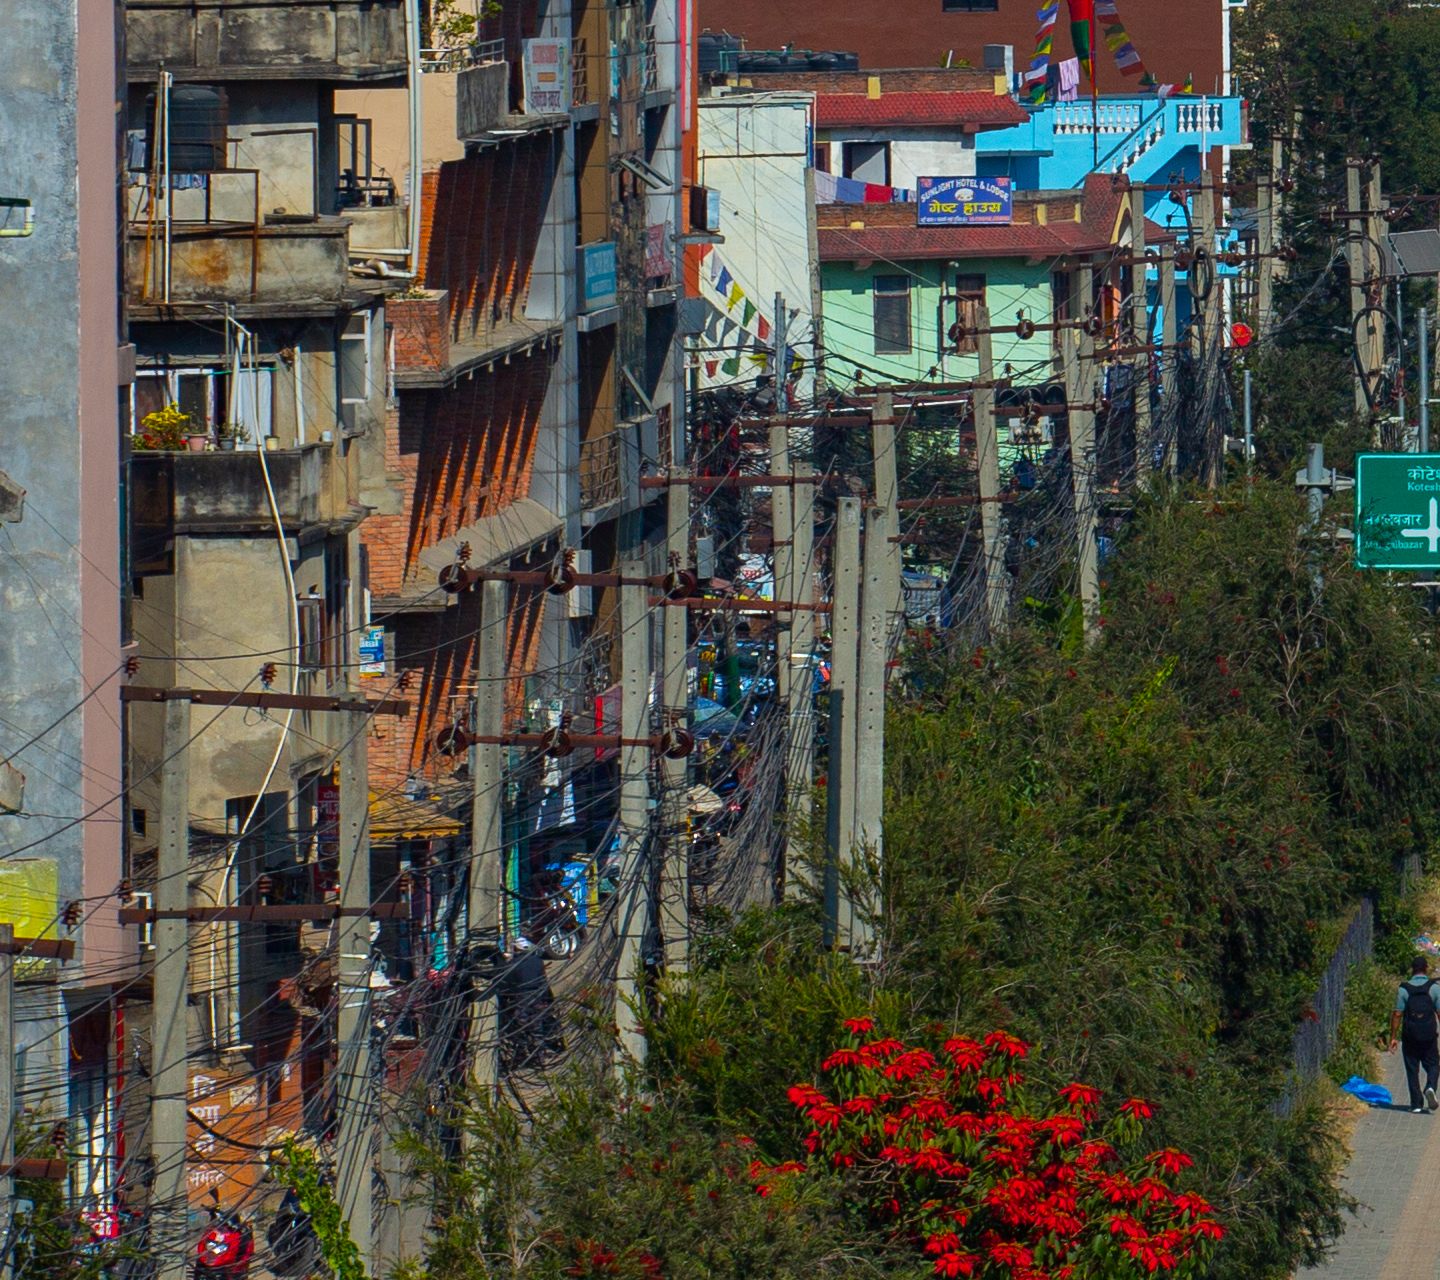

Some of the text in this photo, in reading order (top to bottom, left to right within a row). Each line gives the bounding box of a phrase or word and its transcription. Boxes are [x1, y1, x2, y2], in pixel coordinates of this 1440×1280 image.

[921, 178, 1009, 203] SUNLIGHT HOTEL & LODGE
